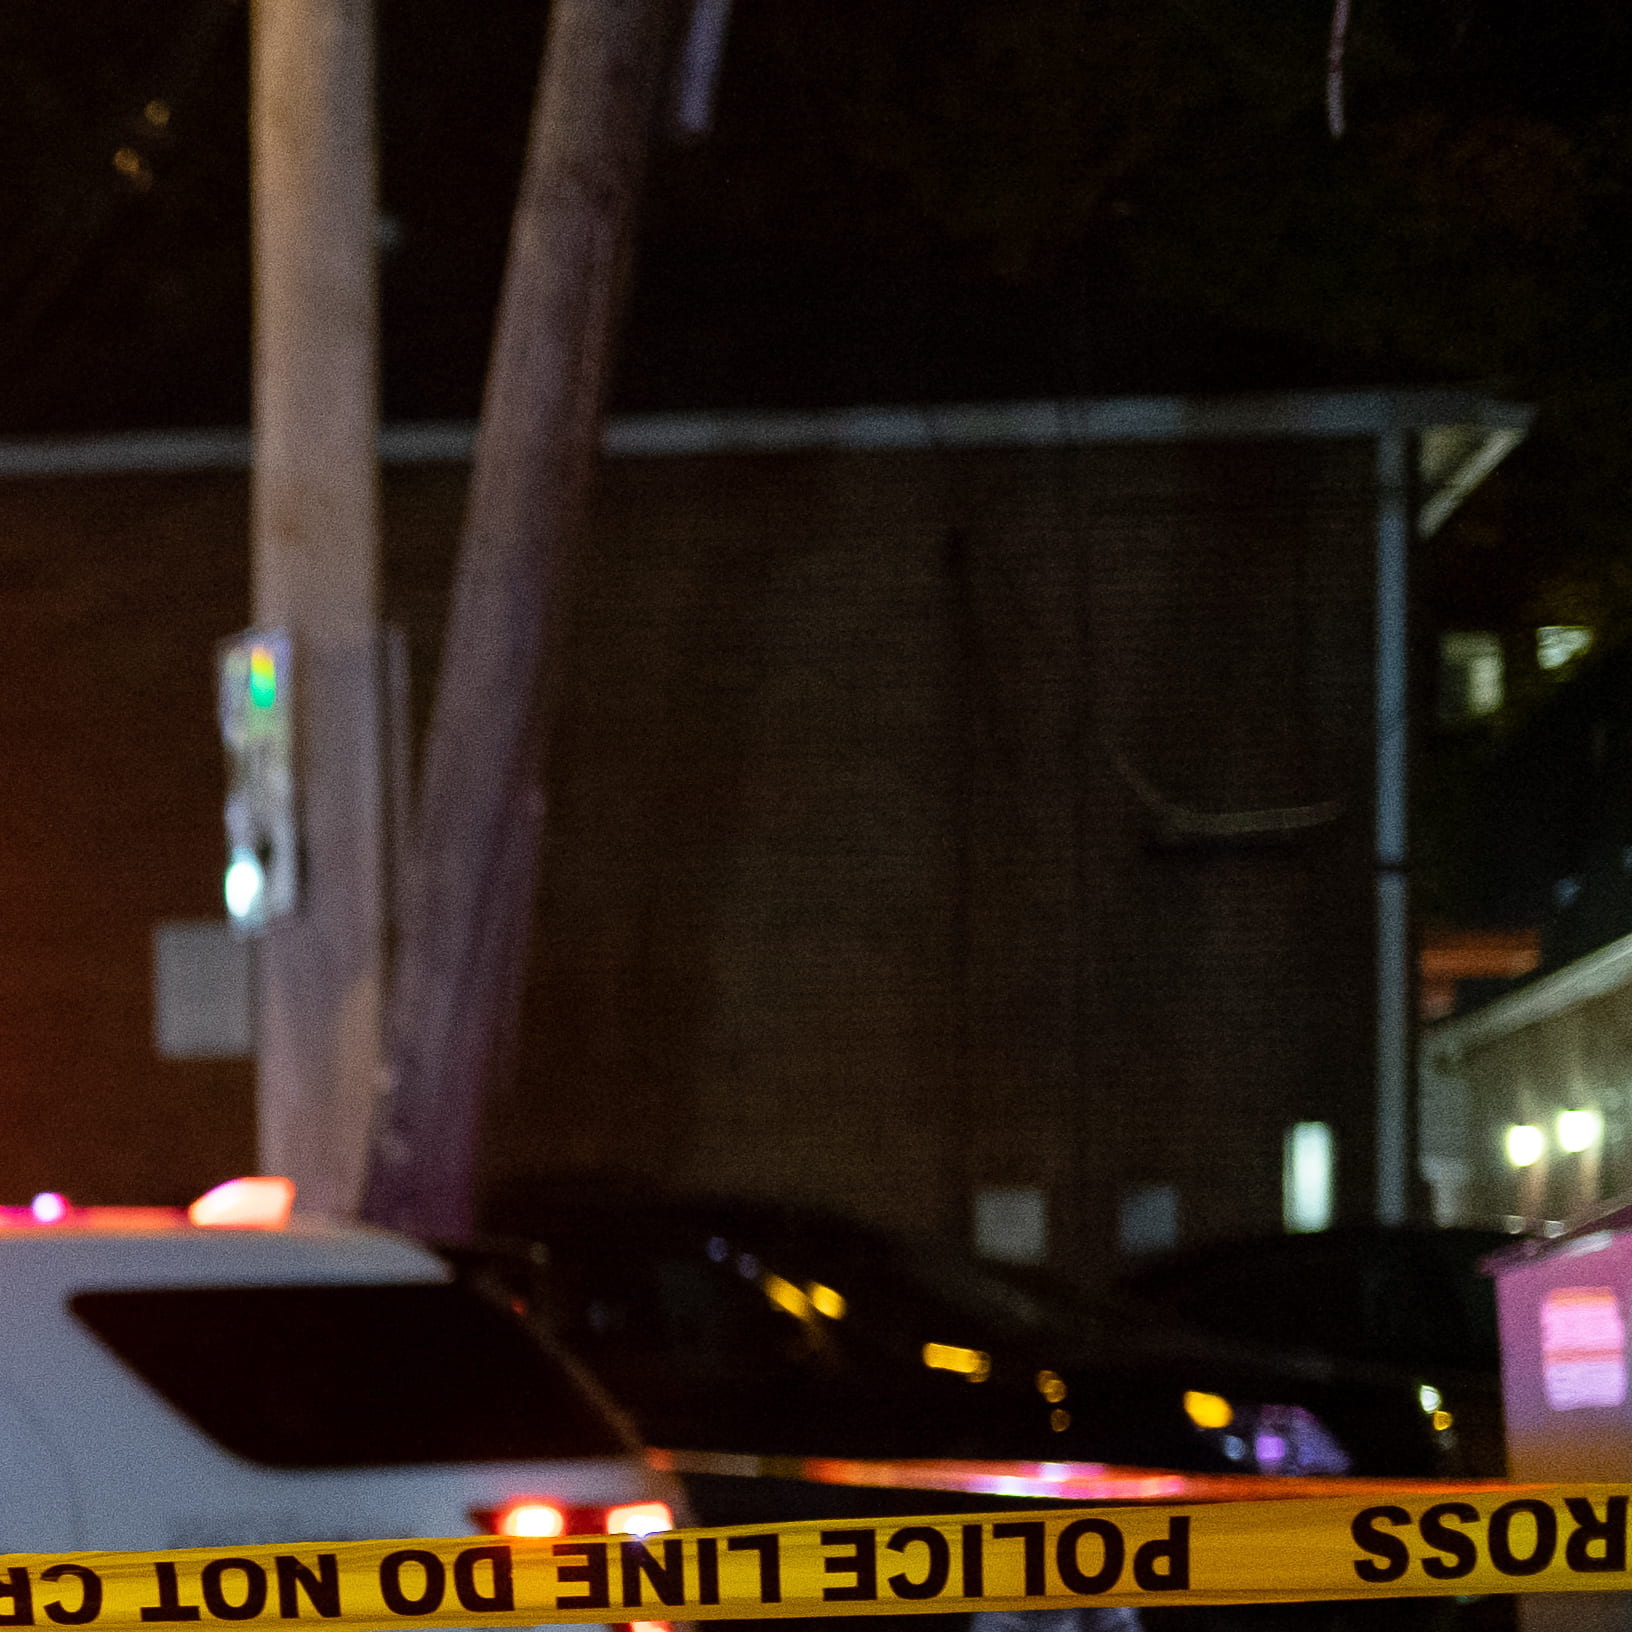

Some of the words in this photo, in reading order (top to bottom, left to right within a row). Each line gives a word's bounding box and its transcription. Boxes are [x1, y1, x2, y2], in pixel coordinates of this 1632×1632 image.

[140, 1553, 342, 1622] NOT
[379, 1546, 516, 1616] DO
[556, 1534, 782, 1610] LINE
[822, 1514, 1191, 1602] POLICE
